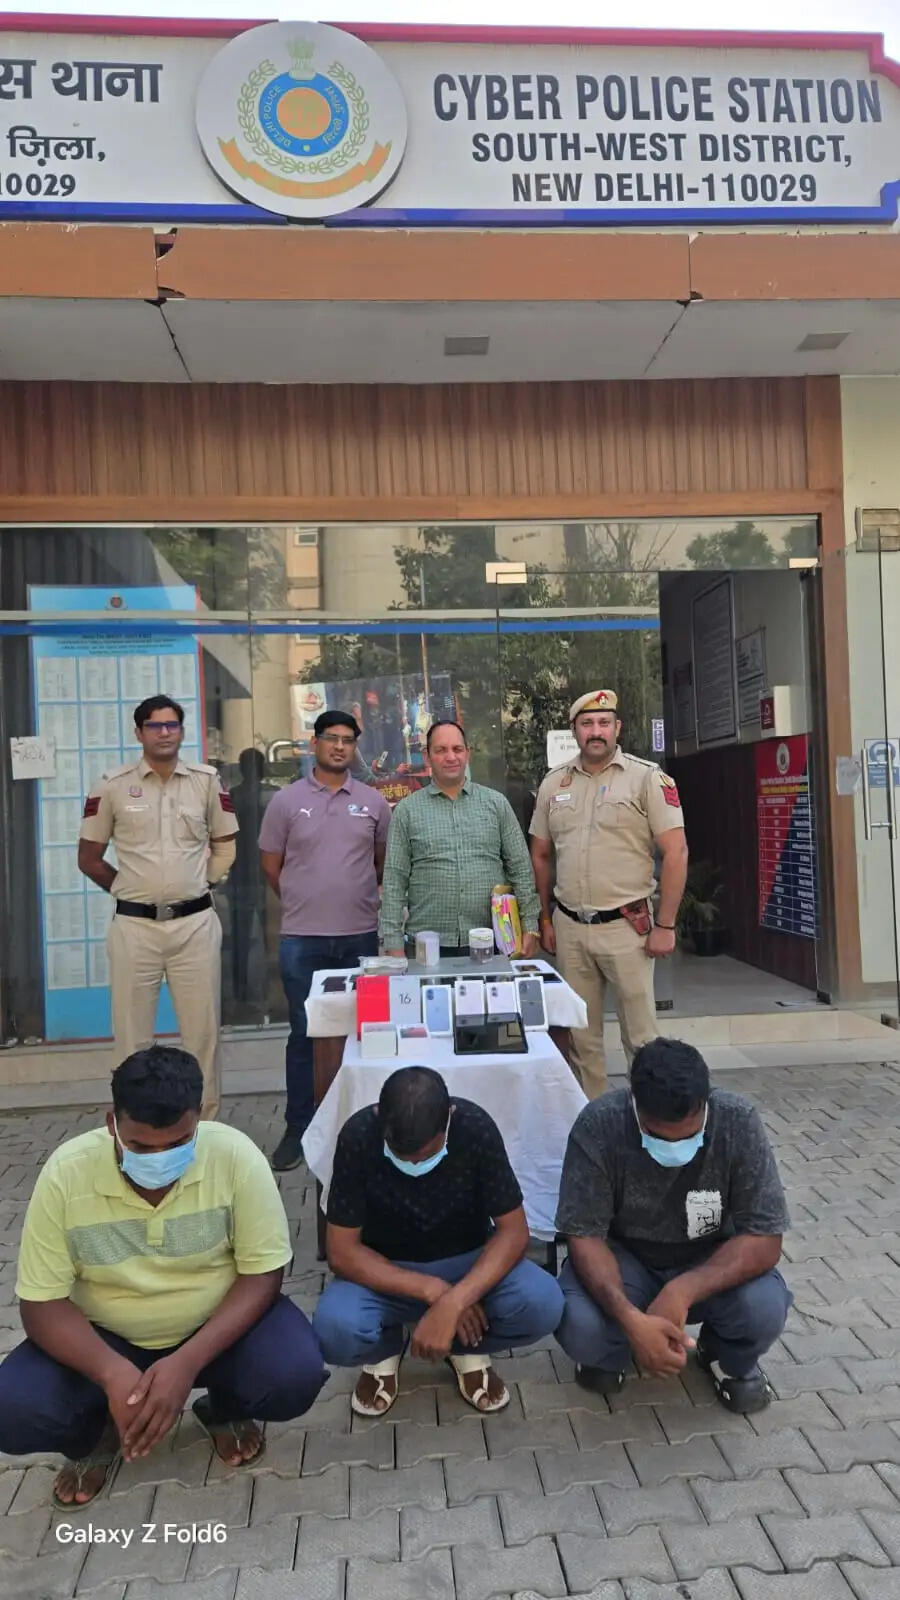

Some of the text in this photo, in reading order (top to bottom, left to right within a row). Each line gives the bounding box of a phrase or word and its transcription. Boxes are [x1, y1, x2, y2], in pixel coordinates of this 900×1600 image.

[51, 61, 163, 102] थाना
[433, 73, 882, 124] CYBER POLICE STATION
[263, 85, 281, 120] POLICE
[472, 132, 852, 168] SOUTH-WEST DISTRICT,
[512, 173, 817, 202] NEW DELHI-110029
[399, 993, 412, 1005] 16
